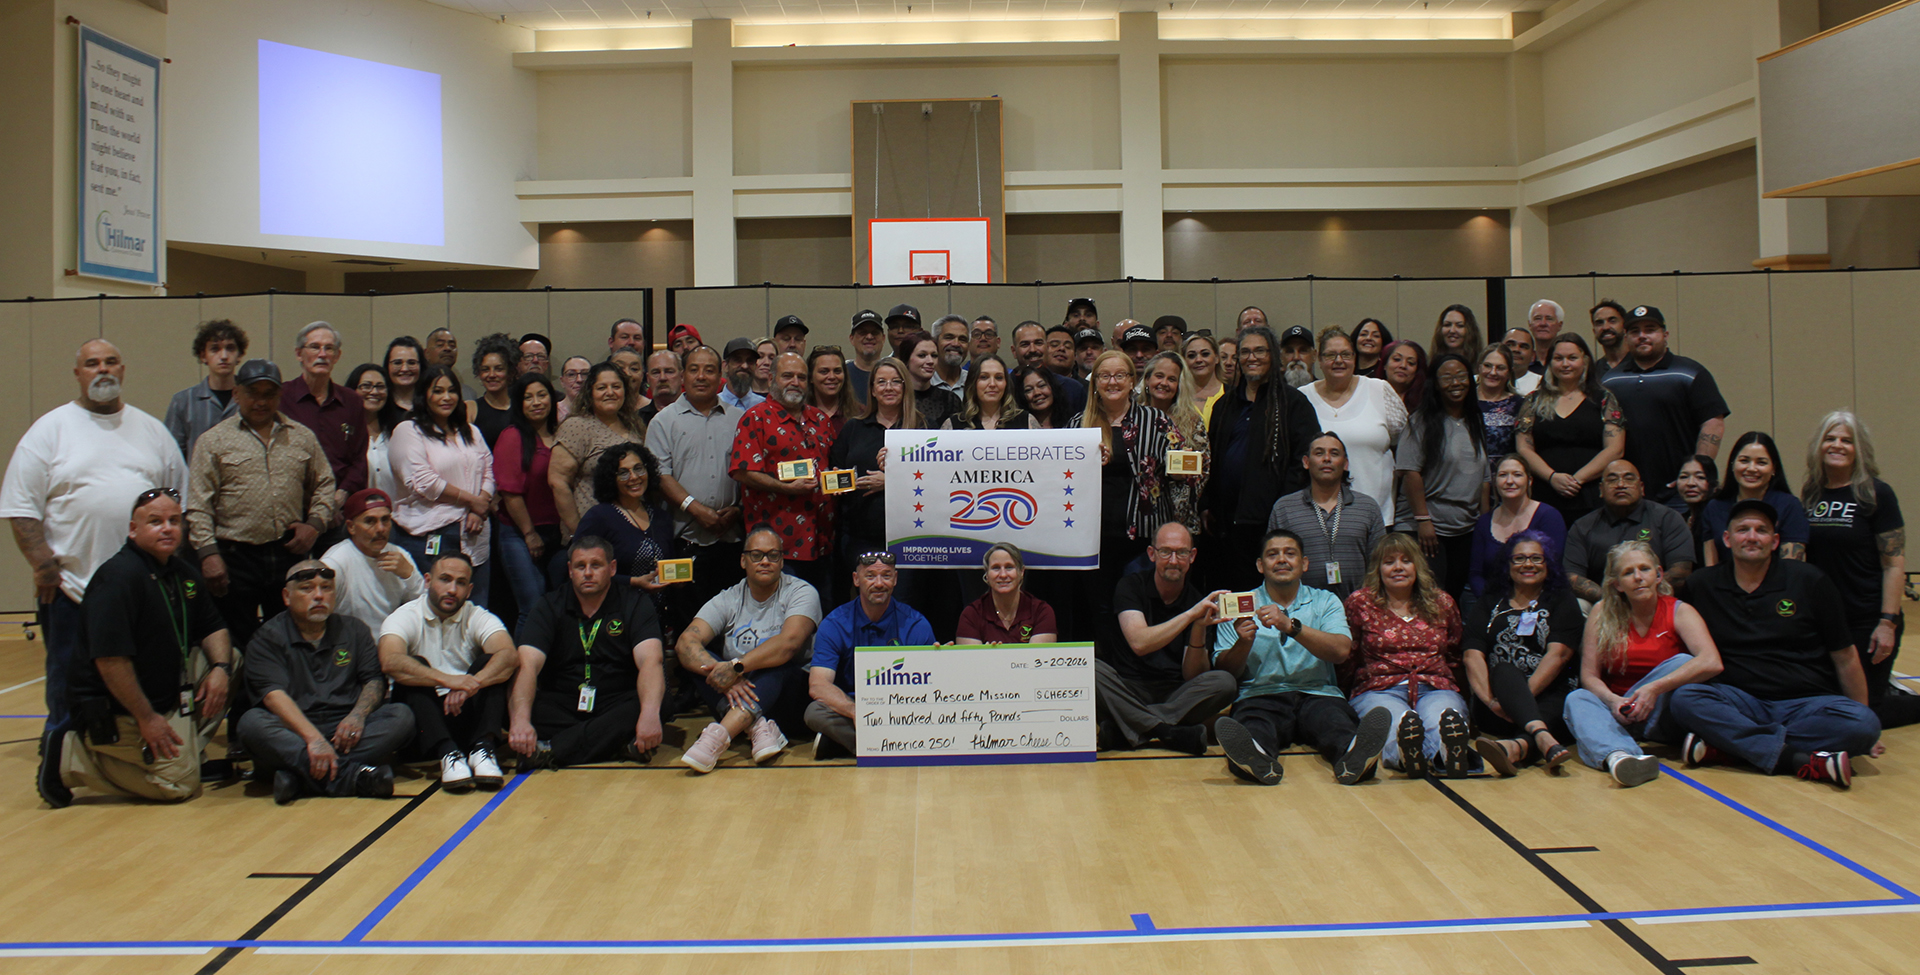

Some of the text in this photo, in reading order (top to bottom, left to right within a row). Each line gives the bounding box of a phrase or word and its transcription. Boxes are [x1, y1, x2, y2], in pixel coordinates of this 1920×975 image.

[106, 64, 120, 81] they
[122, 72, 141, 87] might
[91, 77, 144, 106] be one heart and
[90, 100, 109, 114] mind
[109, 107, 124, 119] with
[90, 118, 141, 144] Then the world
[91, 141, 135, 162] might believe
[91, 160, 104, 173] that
[120, 168, 128, 179] in
[91, 183, 104, 194] sent
[107, 228, 146, 252] Hilmar
[900, 443, 1086, 462] Hilmar CELEBRATES
[950, 469, 1035, 484] AMERICA
[949, 487, 1038, 531] 250
[902, 546, 972, 554] IMPROVING LIVES
[902, 554, 949, 562] TOGETHER
[864, 666, 932, 686] Hilmar
[888, 693, 928, 705] Merced
[933, 689, 975, 703] Rescue
[980, 690, 1021, 701] Mission
[863, 709, 1021, 731] Two hundred and fifty Pounds
[881, 738, 926, 752] America
[970, 734, 1018, 750] Hilmar
[1020, 732, 1052, 748] Cheese
